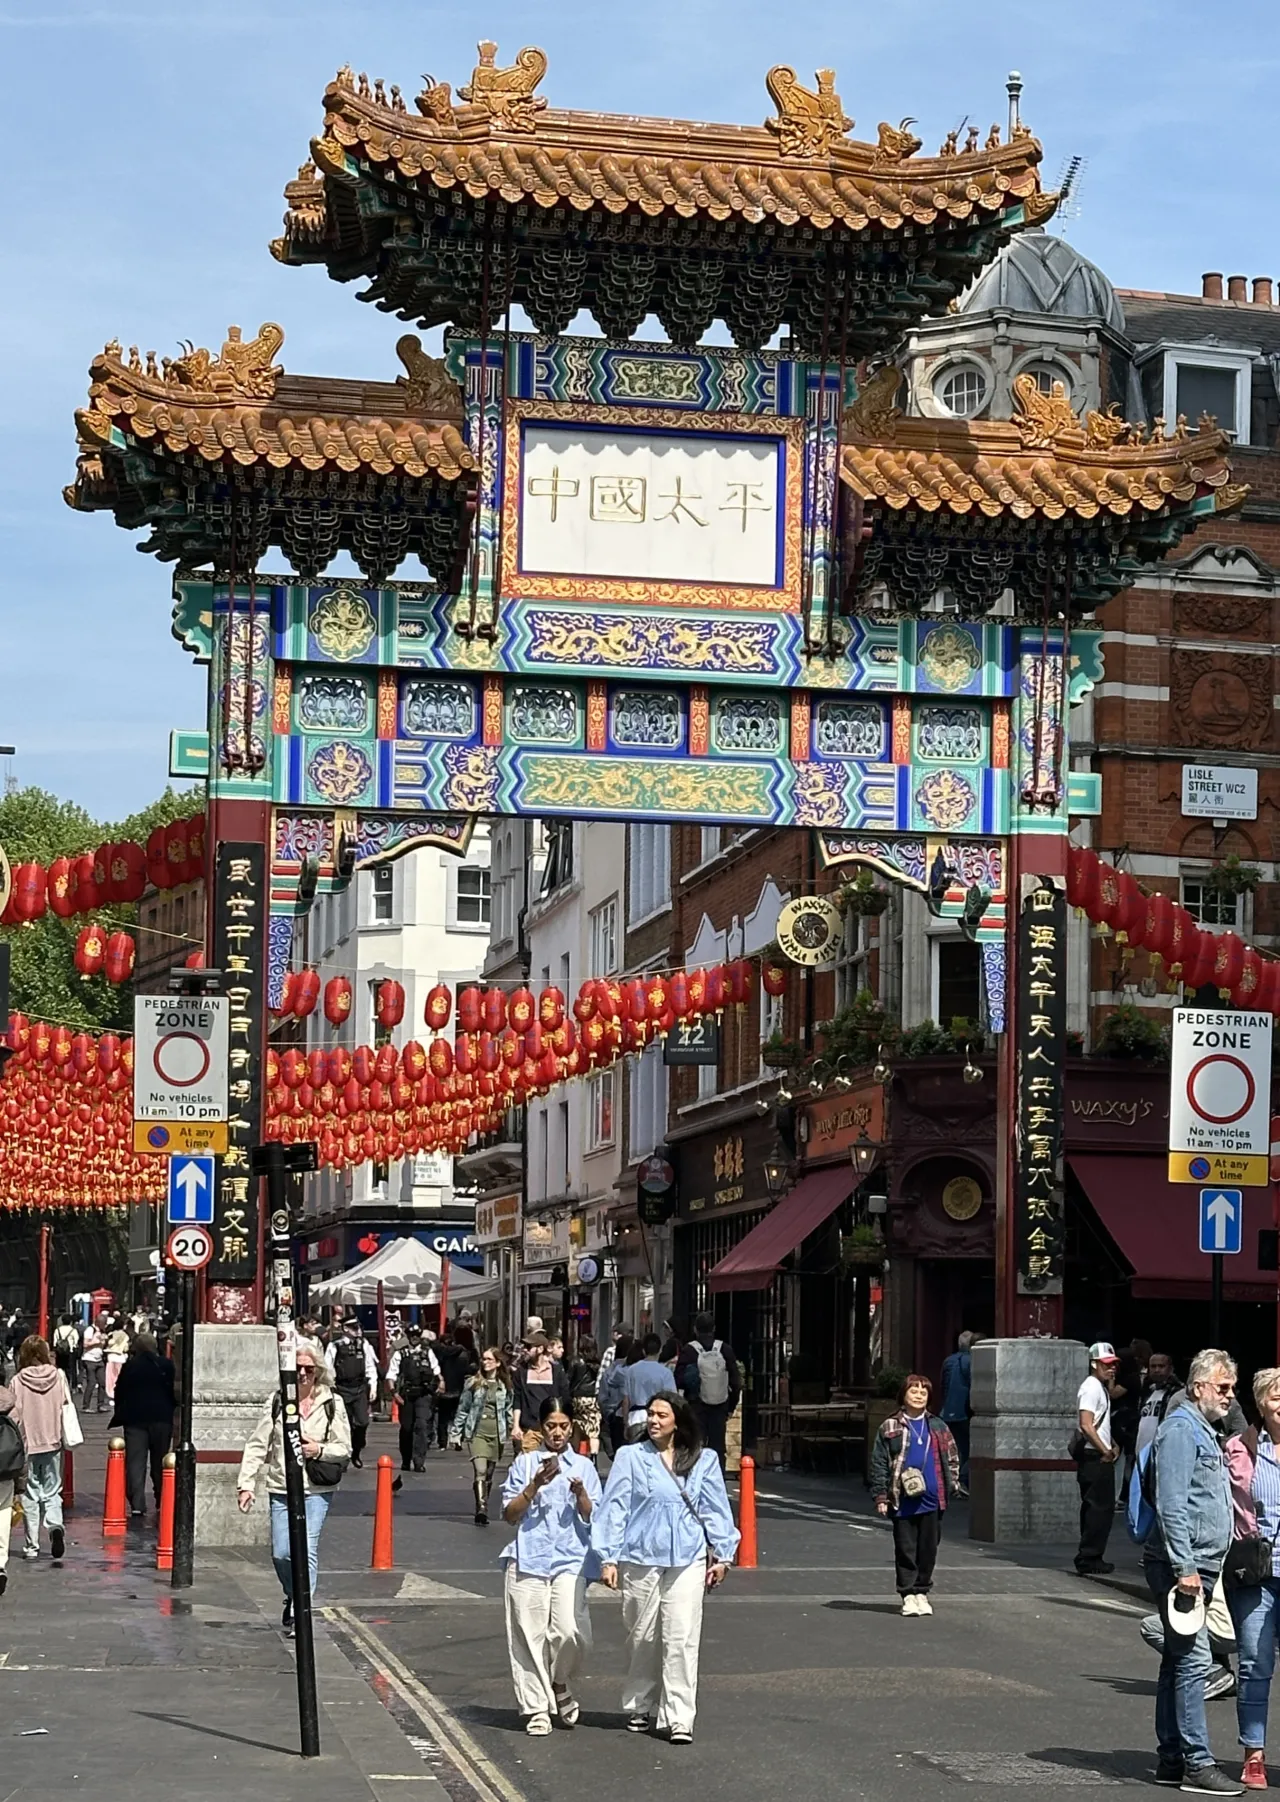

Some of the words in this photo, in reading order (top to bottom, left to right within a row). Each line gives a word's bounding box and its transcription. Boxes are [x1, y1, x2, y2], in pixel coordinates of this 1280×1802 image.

[528, 465, 772, 533] 中國太平
[1188, 769, 1213, 780] LISLE
[1188, 781, 1222, 792] STREET
[1225, 784, 1246, 794] WC2
[145, 1000, 220, 1010] PEDESTRIAN
[155, 1012, 208, 1027] ZONE
[1177, 1012, 1268, 1028] PEDESTRIAN
[1192, 1031, 1251, 1049] ZONE
[150, 1093, 165, 1102] No
[169, 1093, 212, 1103] vehicles
[180, 1127, 194, 1136] At
[196, 1129, 215, 1139] any
[1189, 1127, 1204, 1136] No
[1208, 1128, 1250, 1138] vehicles
[186, 1138, 209, 1148] time
[1214, 1159, 1227, 1168] At
[1230, 1161, 1249, 1170] any
[1219, 1170, 1242, 1180] time
[175, 1239, 207, 1257] 20
